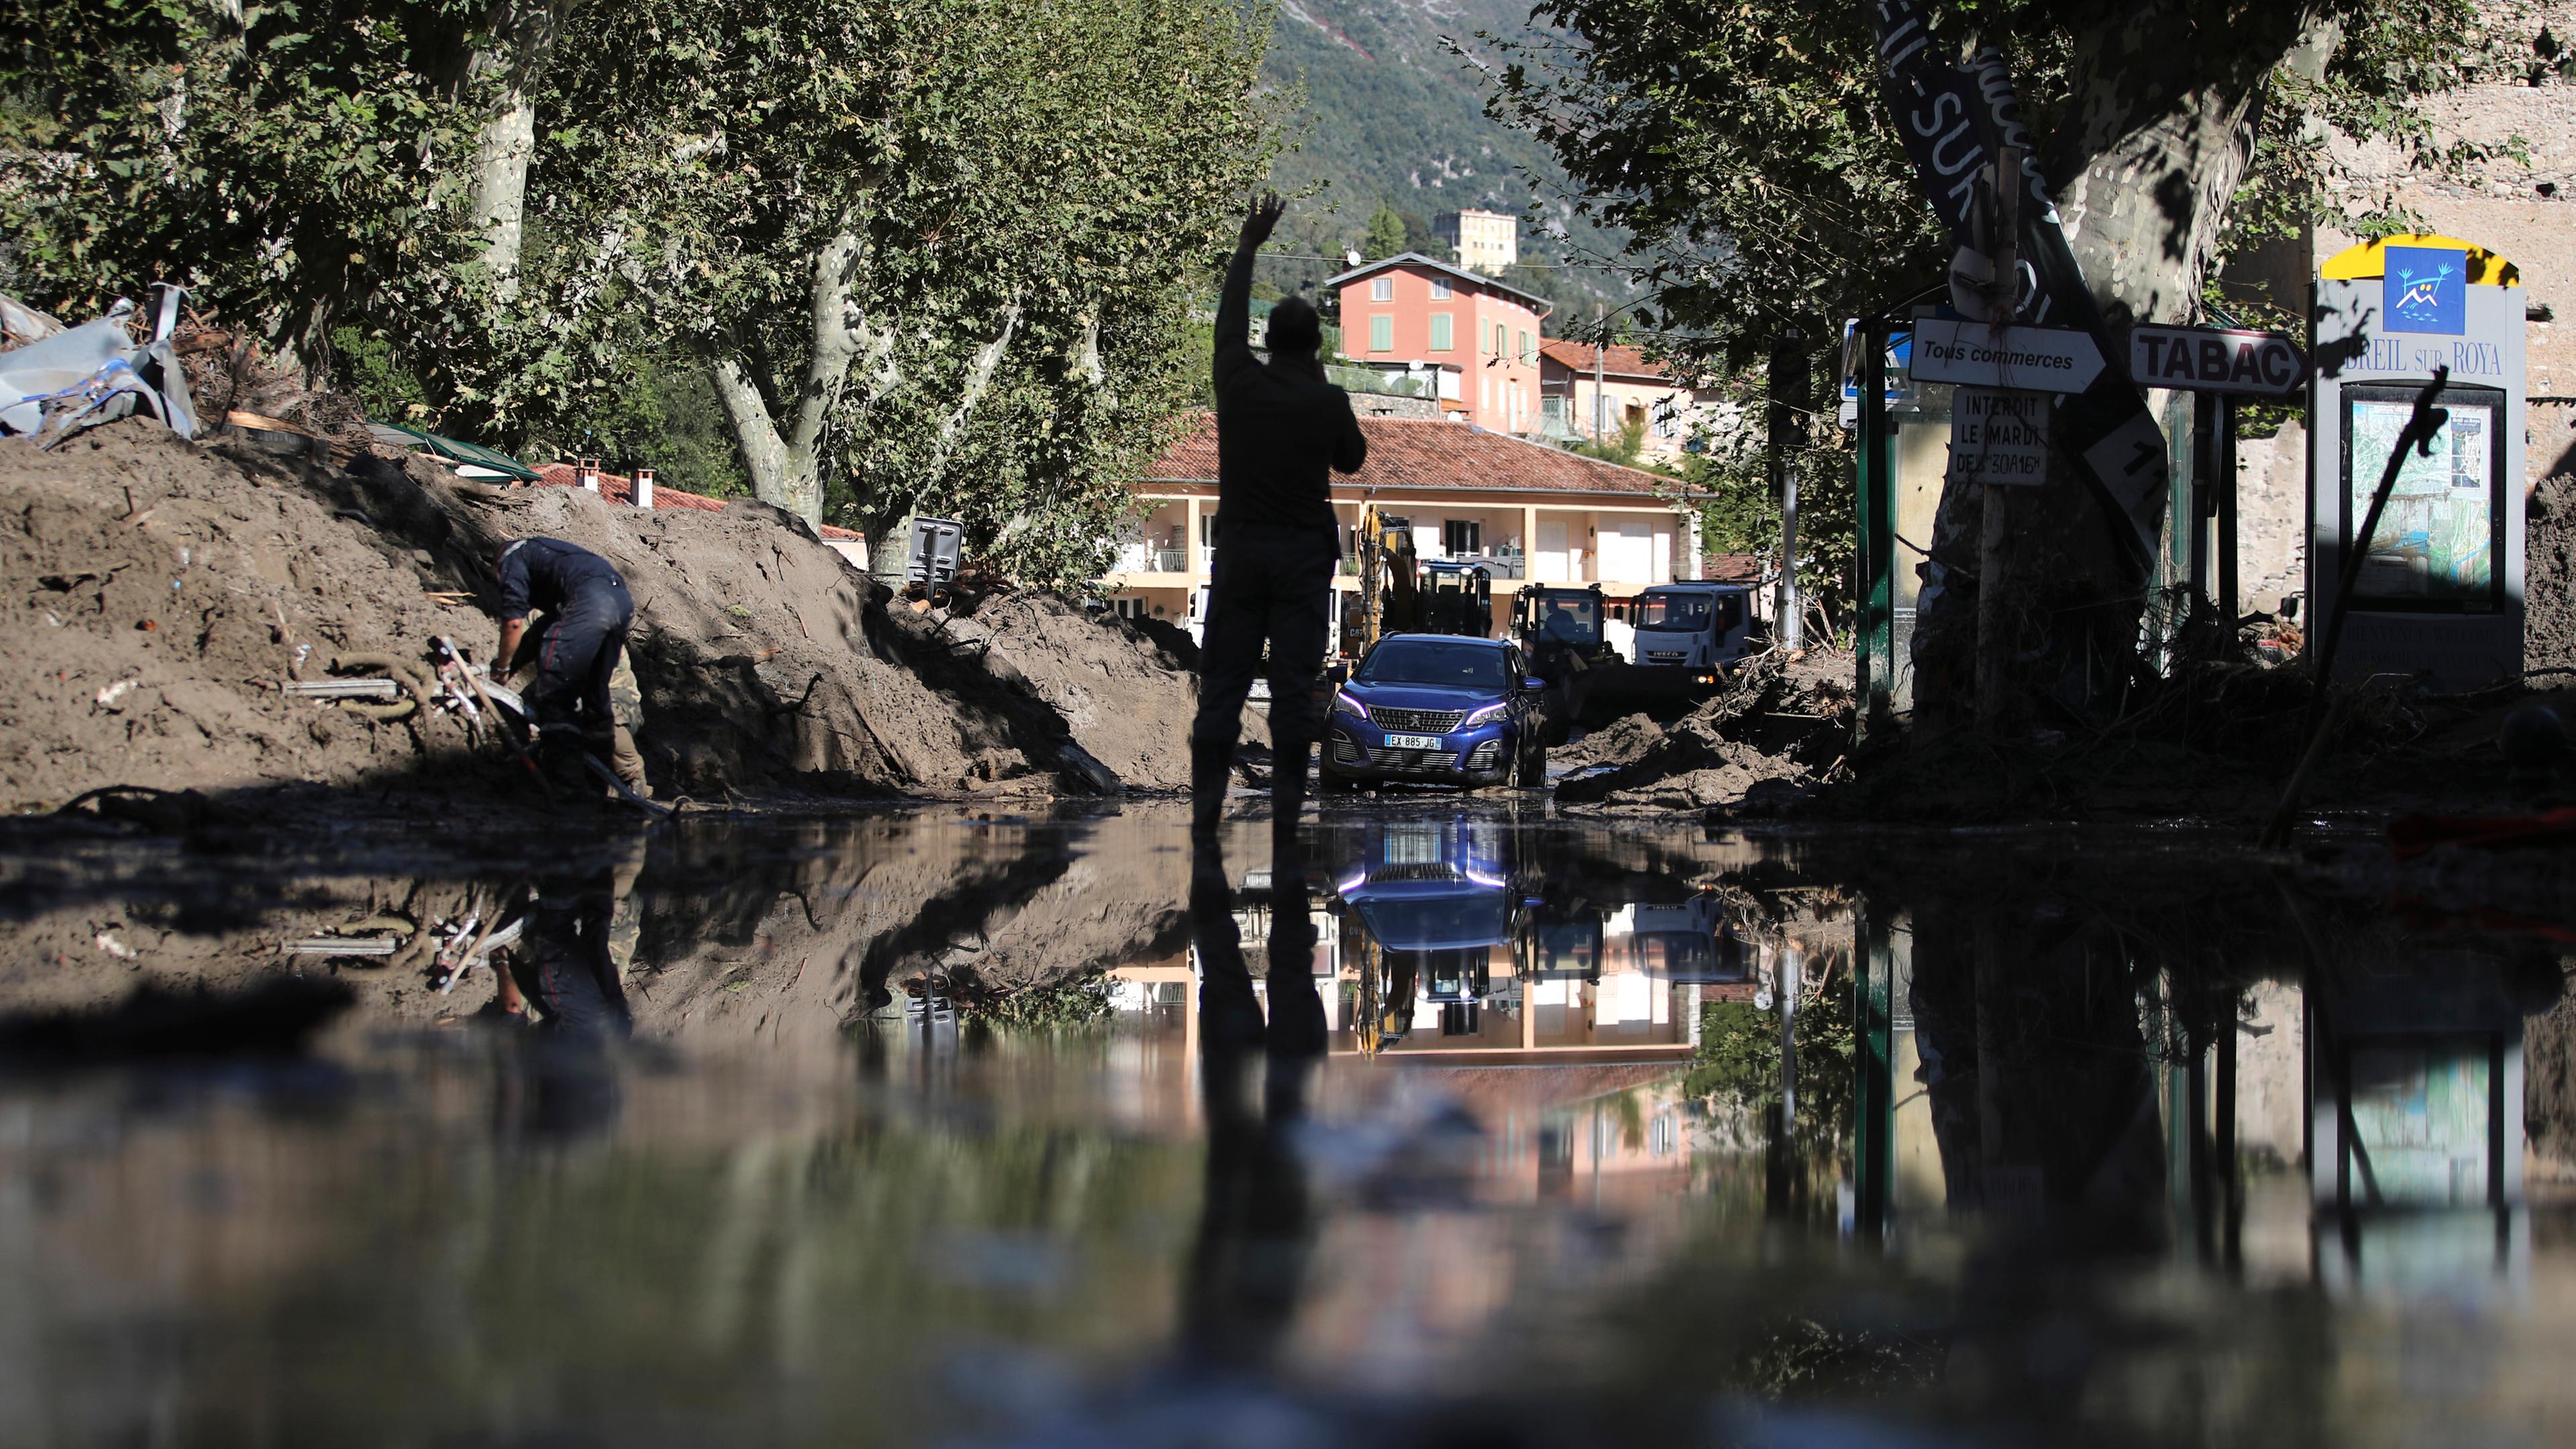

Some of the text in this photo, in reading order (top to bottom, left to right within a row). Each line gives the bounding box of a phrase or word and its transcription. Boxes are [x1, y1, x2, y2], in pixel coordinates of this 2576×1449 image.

[1924, 340, 2074, 370] Tous commerces
[2138, 335, 2291, 386] TABAC
[2345, 338, 2502, 376] BREIL SUR ROYA
[1966, 395, 2038, 417] INTERDIT
[1961, 424, 2039, 446] LE MARDI
[1349, 628, 1363, 637] CAT
